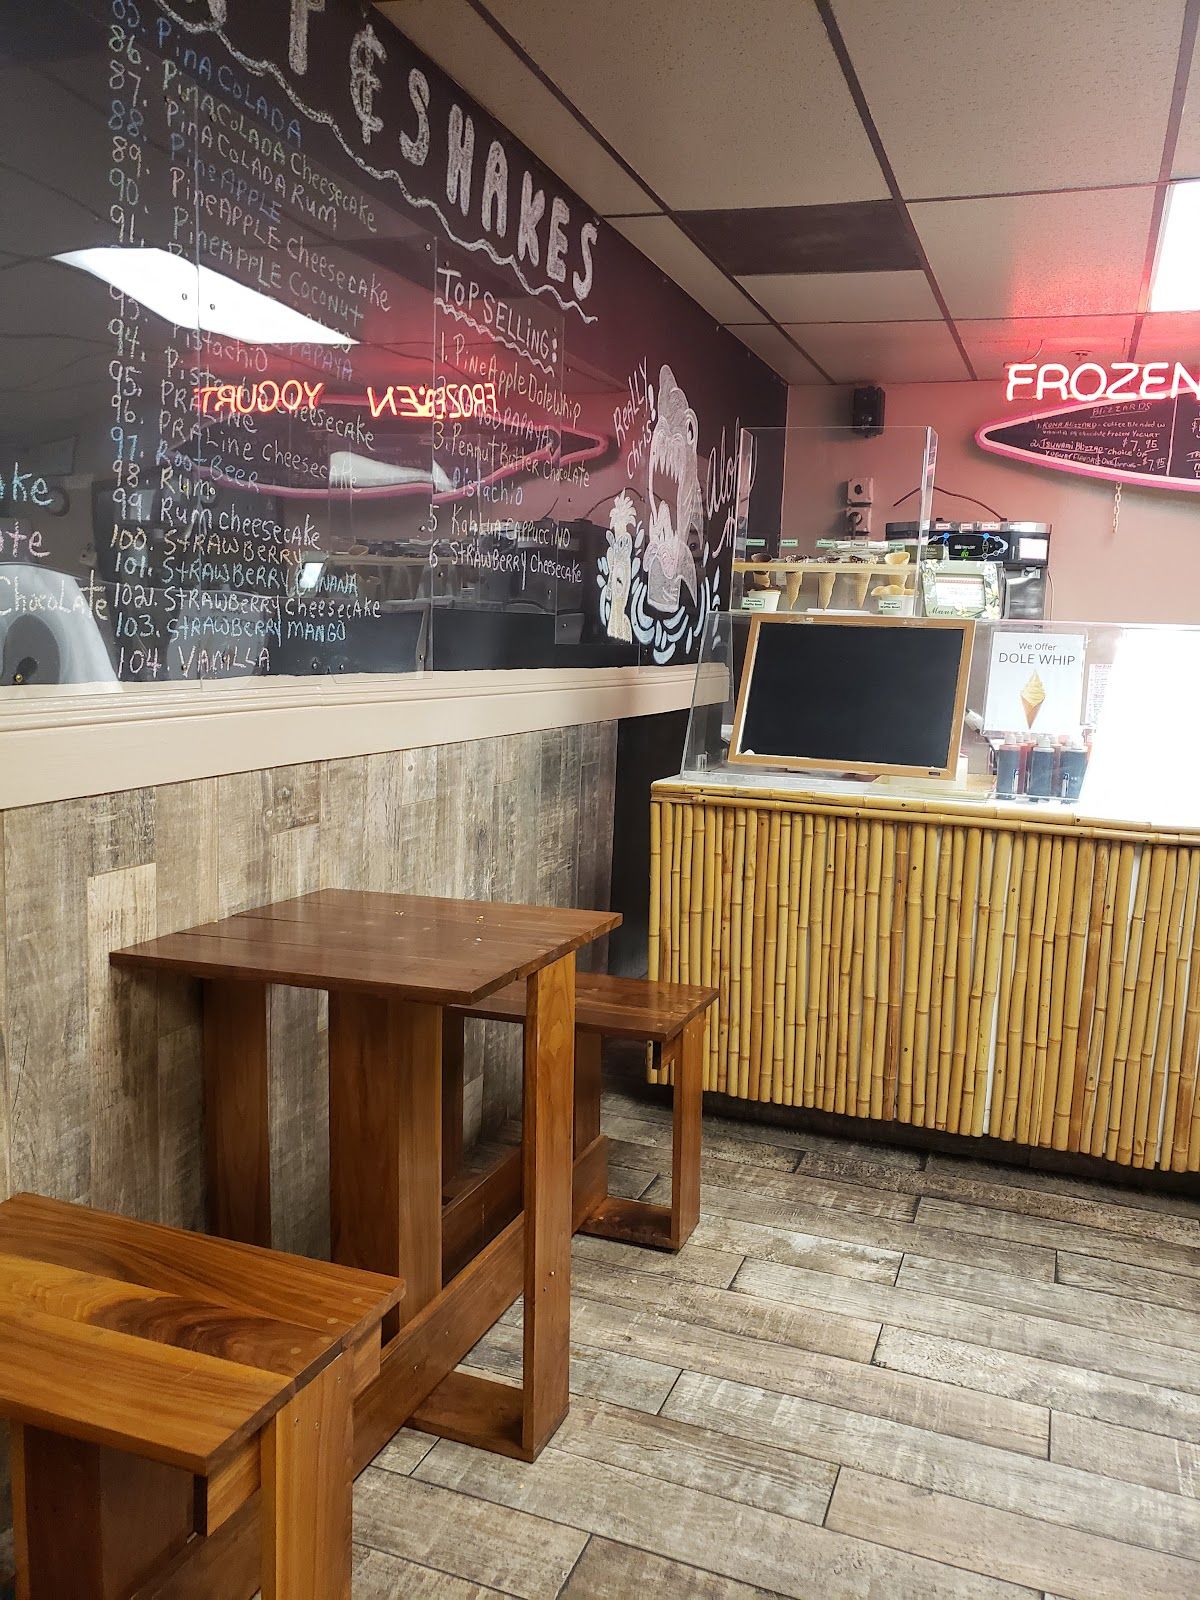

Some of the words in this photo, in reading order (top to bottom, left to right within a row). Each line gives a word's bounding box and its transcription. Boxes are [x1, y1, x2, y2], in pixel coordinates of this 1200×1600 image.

[108, 24, 151, 71] 86.
[109, 59, 149, 107] 87.
[107, 99, 148, 142] 88.
[111, 136, 151, 176] 89.
[108, 167, 149, 214] 90.
[1005, 362, 1200, 401] FROZEN
[111, 394, 144, 424] 96.
[111, 459, 150, 489] 98.
[111, 487, 151, 523] 99.
[110, 523, 154, 552] 100.
[114, 552, 153, 579] 101.
[114, 582, 158, 609] 102.
[116, 612, 161, 638] 103.
[998, 652, 1035, 664] DOLE
[1038, 655, 1076, 667] WHIP
[1018, 642, 1033, 650] We
[1034, 643, 1057, 651] Offer
[117, 647, 171, 679] 104.
